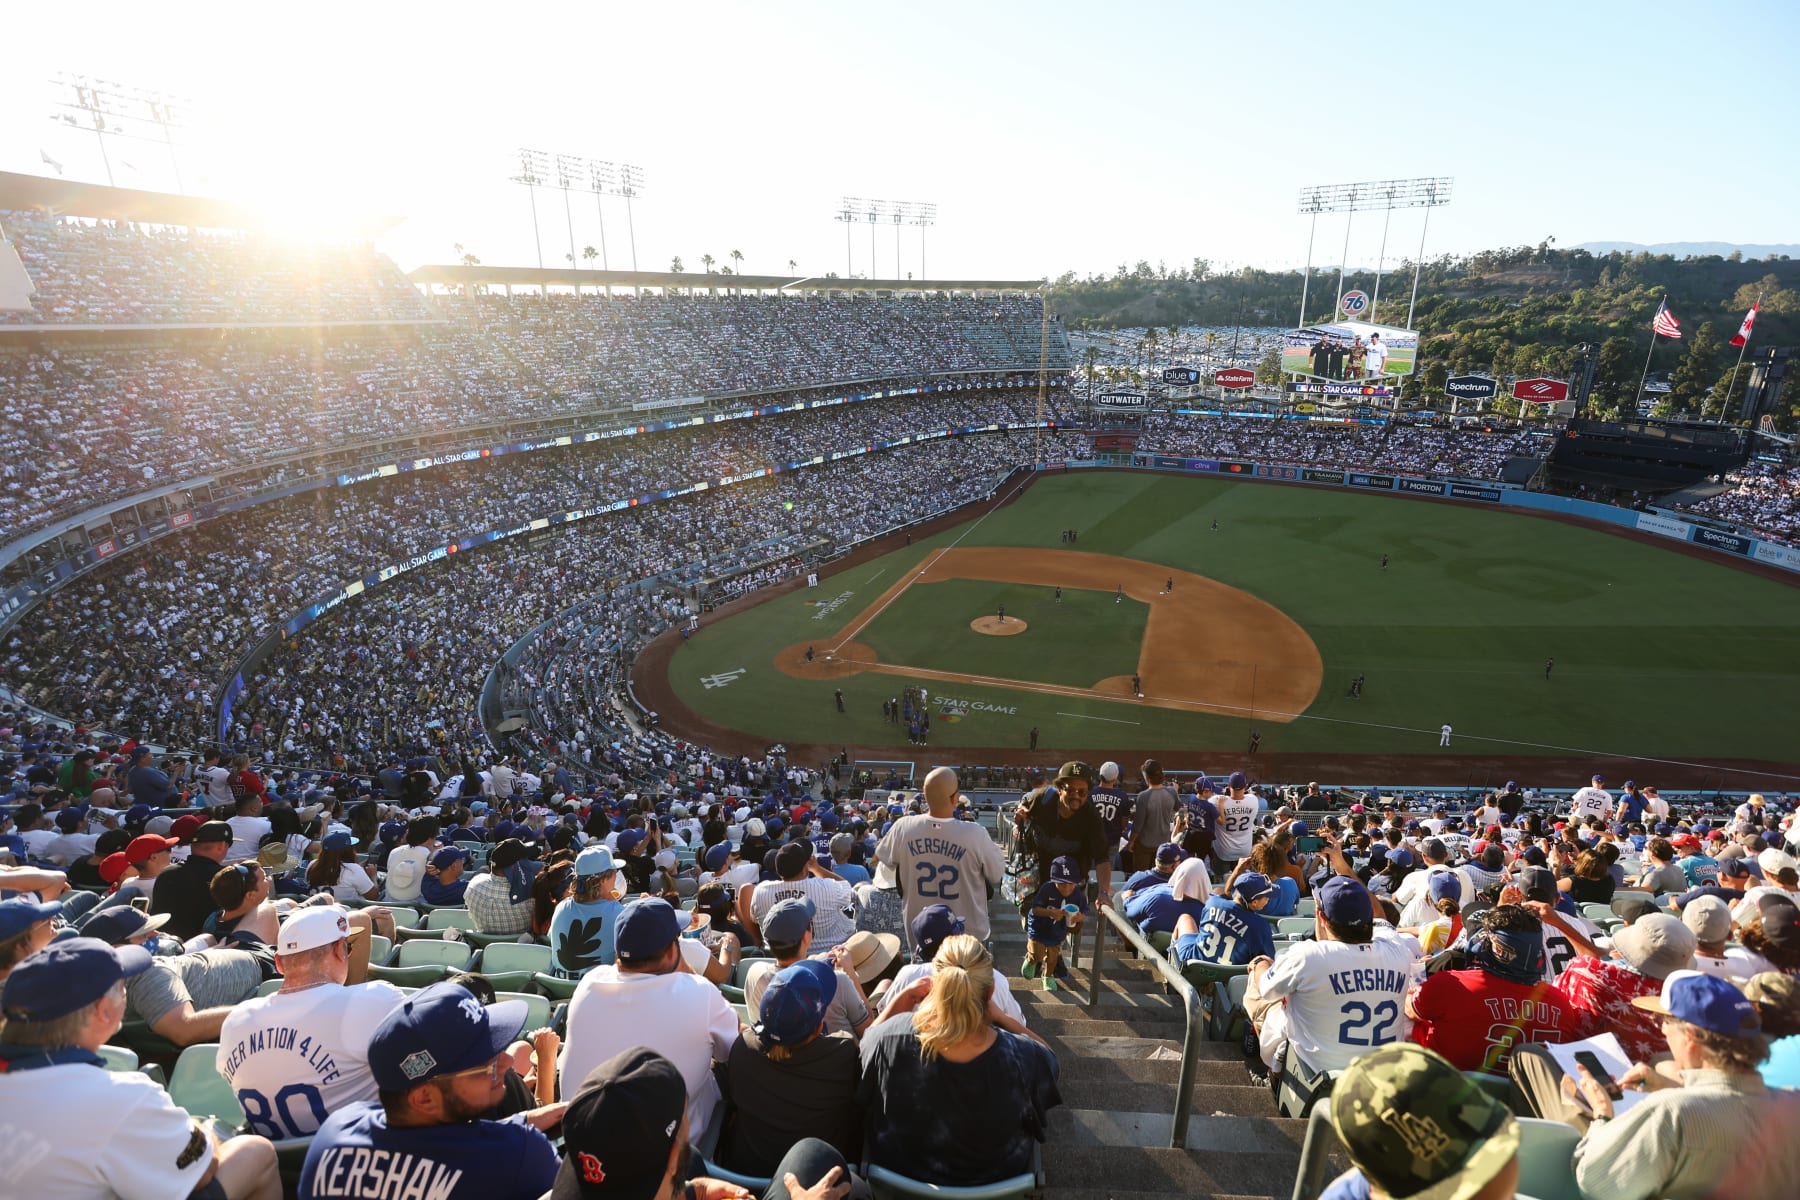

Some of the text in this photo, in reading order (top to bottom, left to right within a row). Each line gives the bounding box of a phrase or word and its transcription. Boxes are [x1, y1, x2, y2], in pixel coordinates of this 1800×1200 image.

[1344, 296, 1364, 310] 76
[1166, 370, 1187, 380] blue
[1340, 384, 1362, 395] GAME
[1450, 382, 1489, 392] Spectrum
[1100, 395, 1142, 404] CUTWATER
[1370, 478, 1390, 486] Health
[1410, 482, 1442, 492] MORTON
[1704, 531, 1738, 545] Spectrum
[932, 696, 1017, 714] STAR GAME
[1092, 794, 1121, 806] ROBERTS
[1587, 798, 1602, 809] 22
[1096, 802, 1117, 821] 30
[1226, 817, 1249, 832] 22
[908, 838, 967, 862] KERSHAW
[916, 861, 959, 900] 22
[774, 888, 806, 904] JUDGE
[1209, 906, 1249, 938] PIAZZA
[1198, 923, 1236, 965] 31
[1328, 969, 1406, 995] KERSHAW
[1485, 998, 1561, 1028] TROUT
[1338, 1000, 1398, 1046] 22
[250, 1027, 298, 1055] NATION
[300, 1036, 312, 1058] 4
[309, 1044, 340, 1085] LIFE
[238, 1083, 330, 1140] 80
[312, 1148, 462, 1200] KERSHAW
[578, 1152, 606, 1184] B
